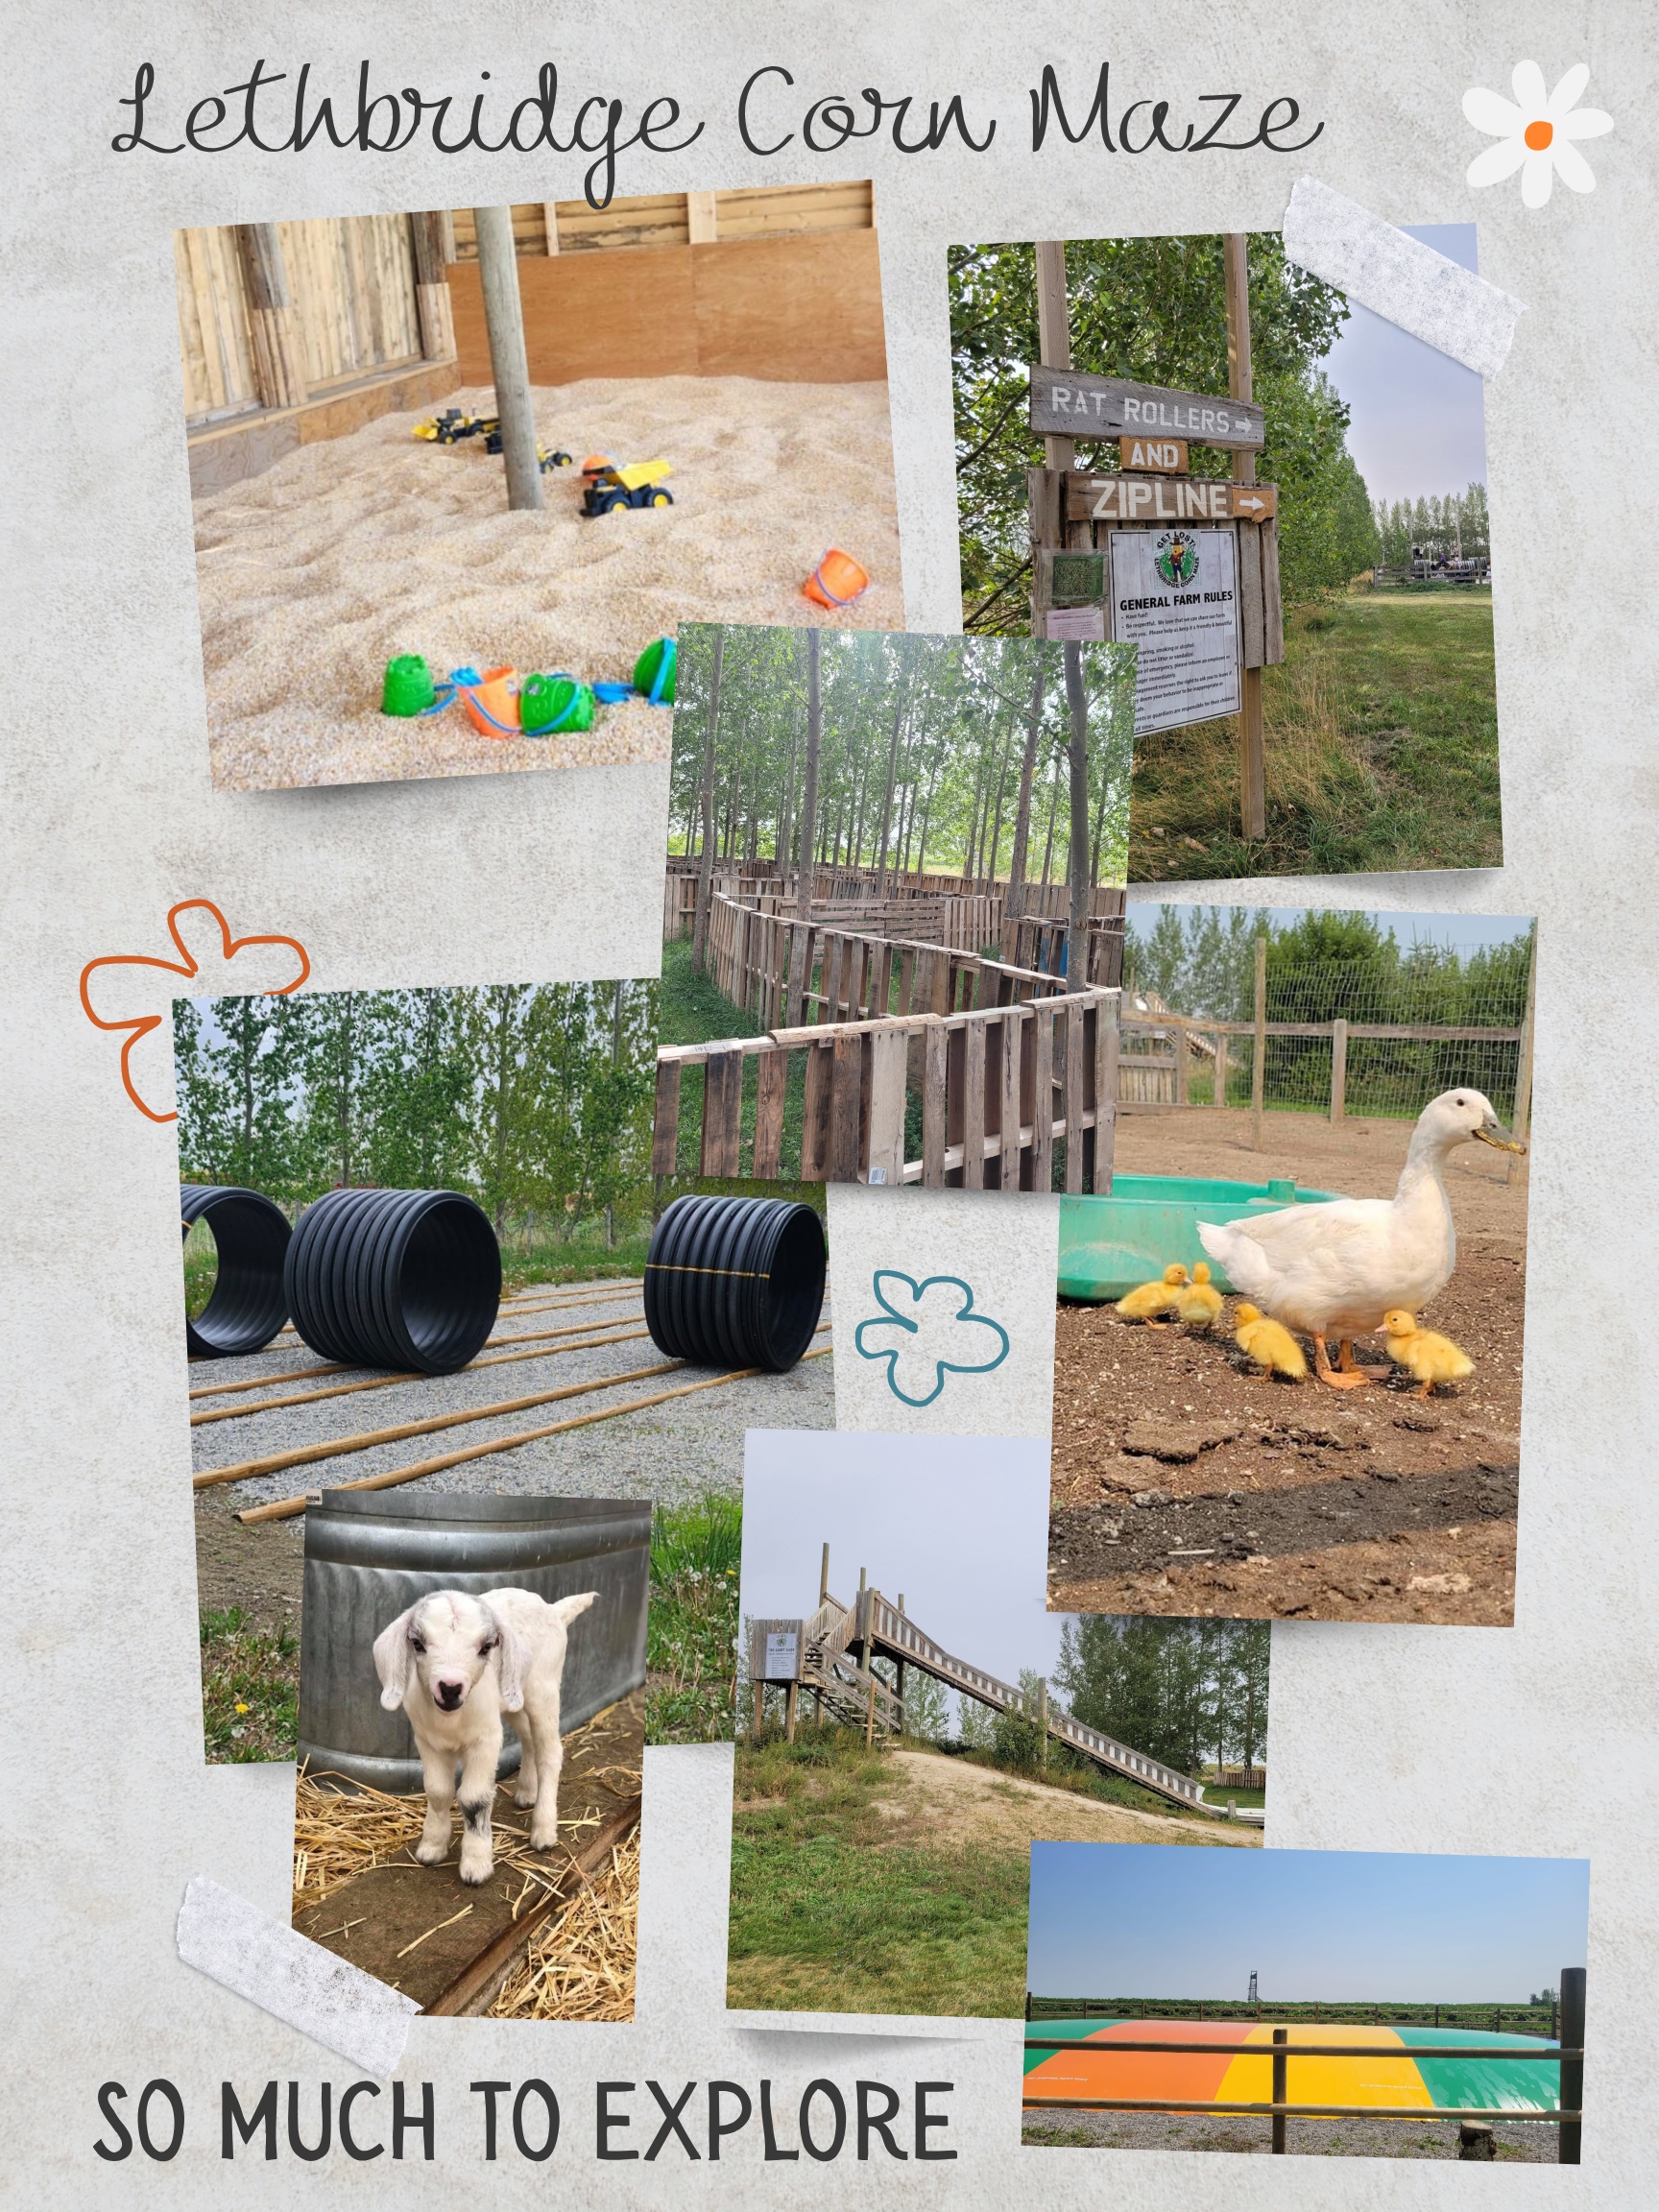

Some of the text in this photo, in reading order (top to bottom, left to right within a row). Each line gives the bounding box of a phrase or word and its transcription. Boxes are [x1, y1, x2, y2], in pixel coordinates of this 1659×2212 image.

[1051, 386, 1230, 434] RAT ROLLERS
[1131, 442, 1179, 468] AND
[1091, 480, 1228, 518] ZIPLINE
[1157, 532, 1171, 548] GET
[1154, 558, 1180, 589] LETHBRIDGE
[1180, 574, 1195, 588] CORN
[1119, 590, 1234, 612] GENERAL FARM RULES
[1153, 692, 1163, 701] your
[1163, 688, 1182, 697] behavior
[1192, 683, 1218, 691] inappropriate
[1152, 709, 1174, 719] guardians
[1181, 702, 1204, 712] responsible
